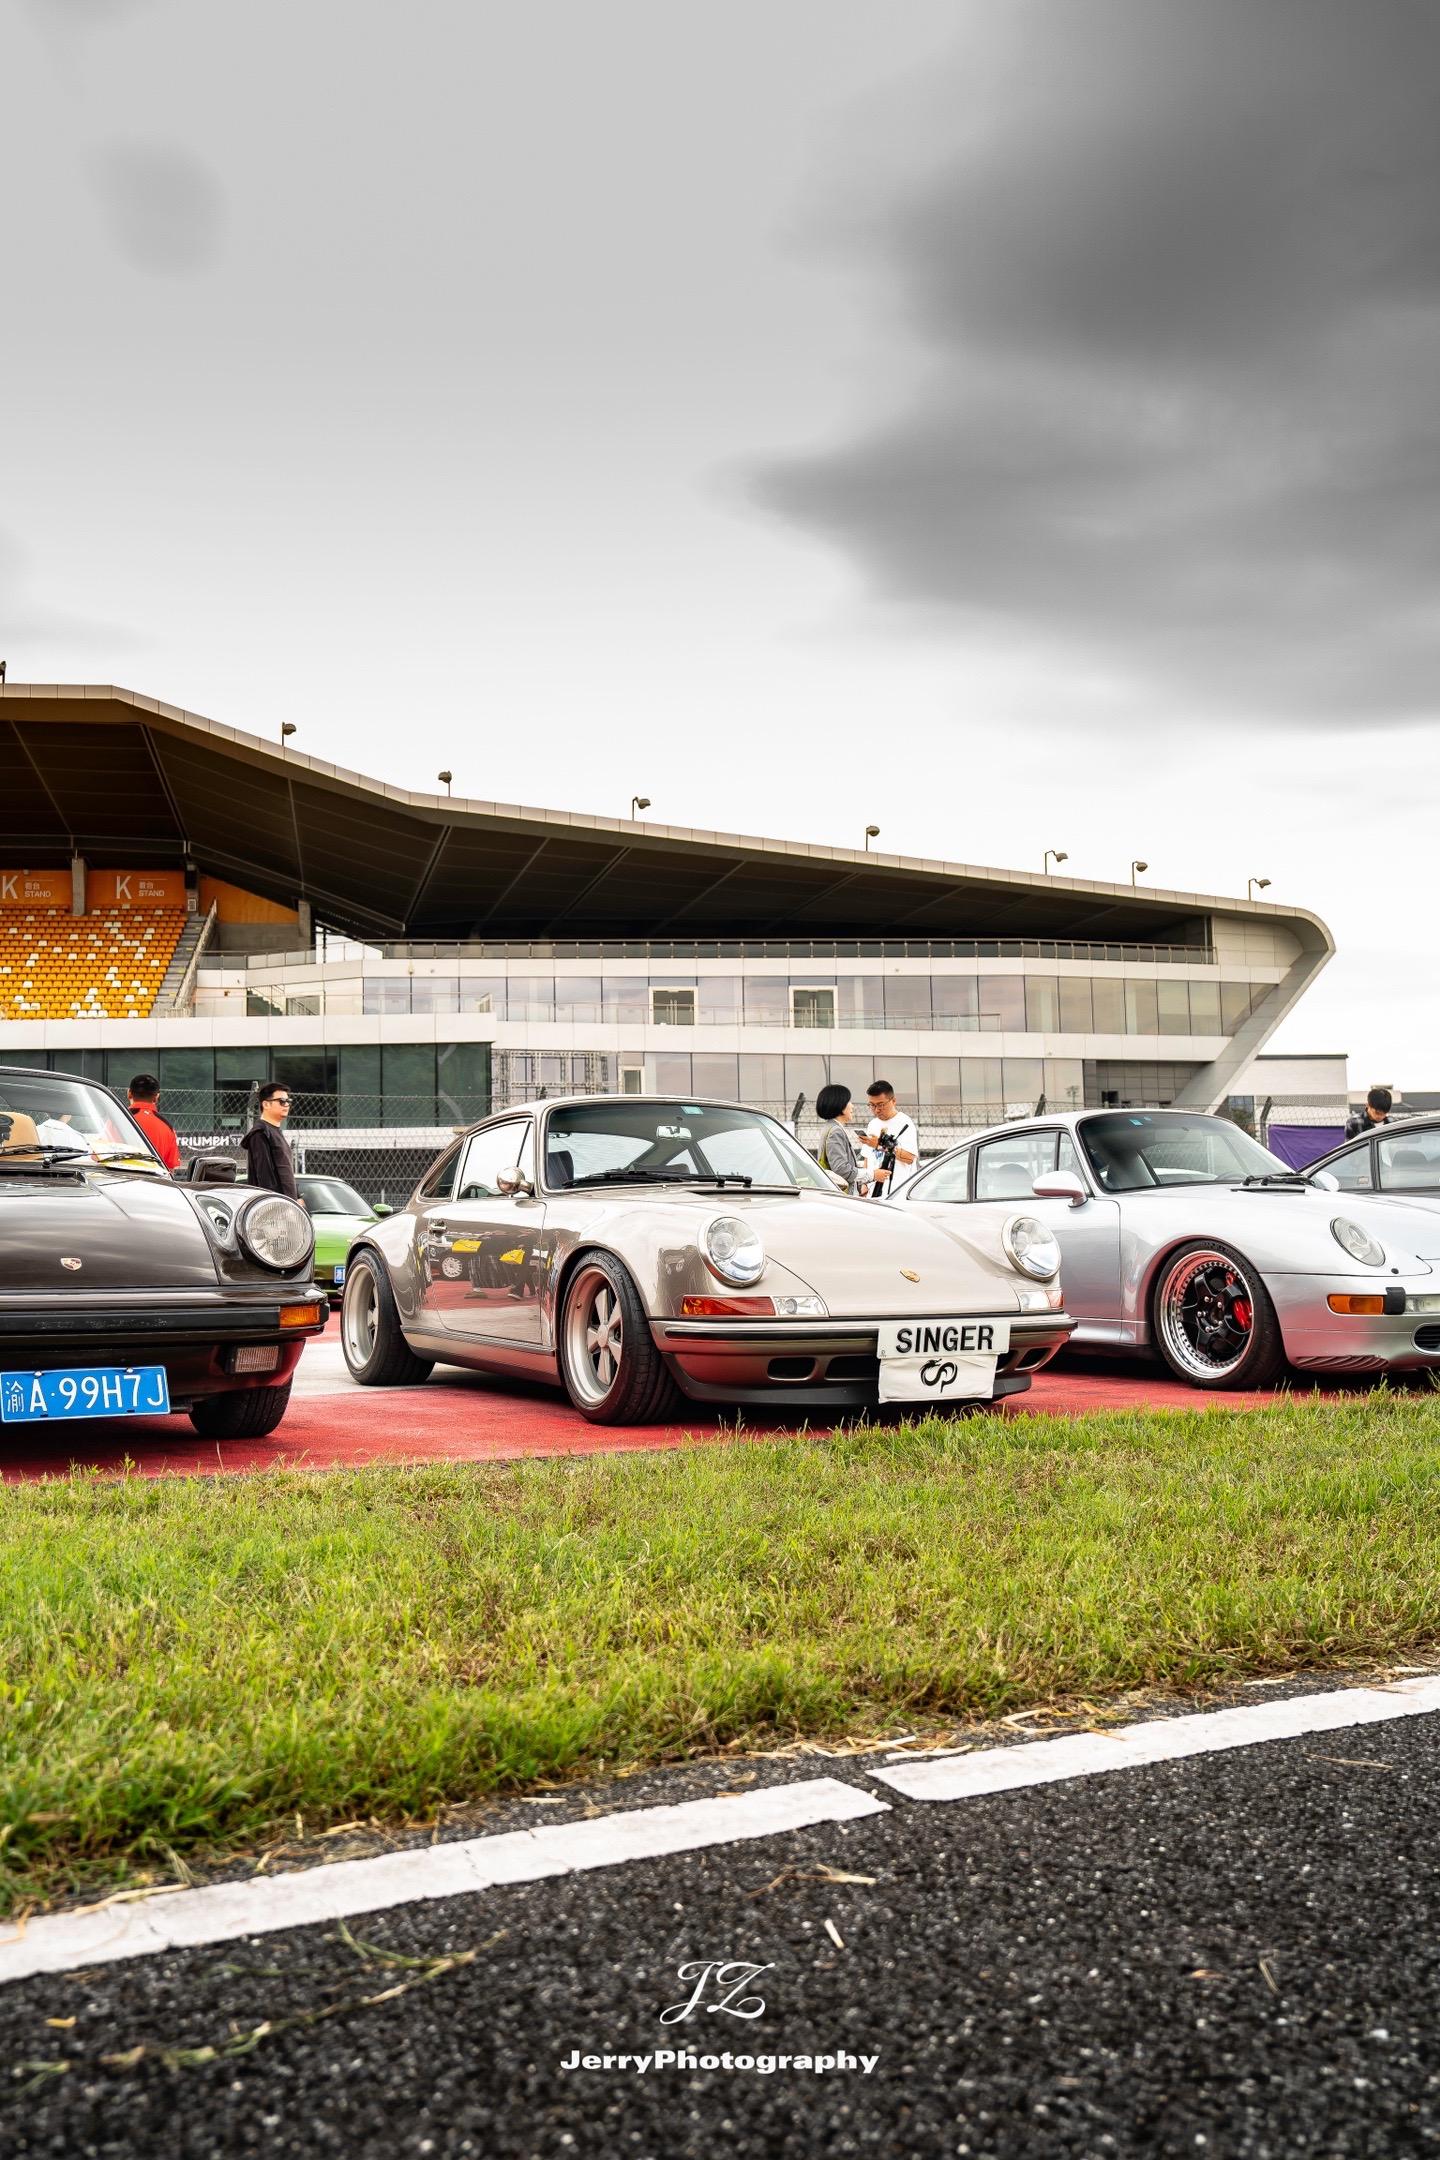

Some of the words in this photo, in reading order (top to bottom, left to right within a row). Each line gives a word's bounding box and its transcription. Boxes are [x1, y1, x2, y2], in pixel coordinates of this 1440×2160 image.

[2, 875, 18, 899] K
[116, 875, 132, 899] K
[138, 889, 165, 897] STAND
[176, 1135, 230, 1149] TRIUMPH
[895, 1324, 994, 1353] SINGER
